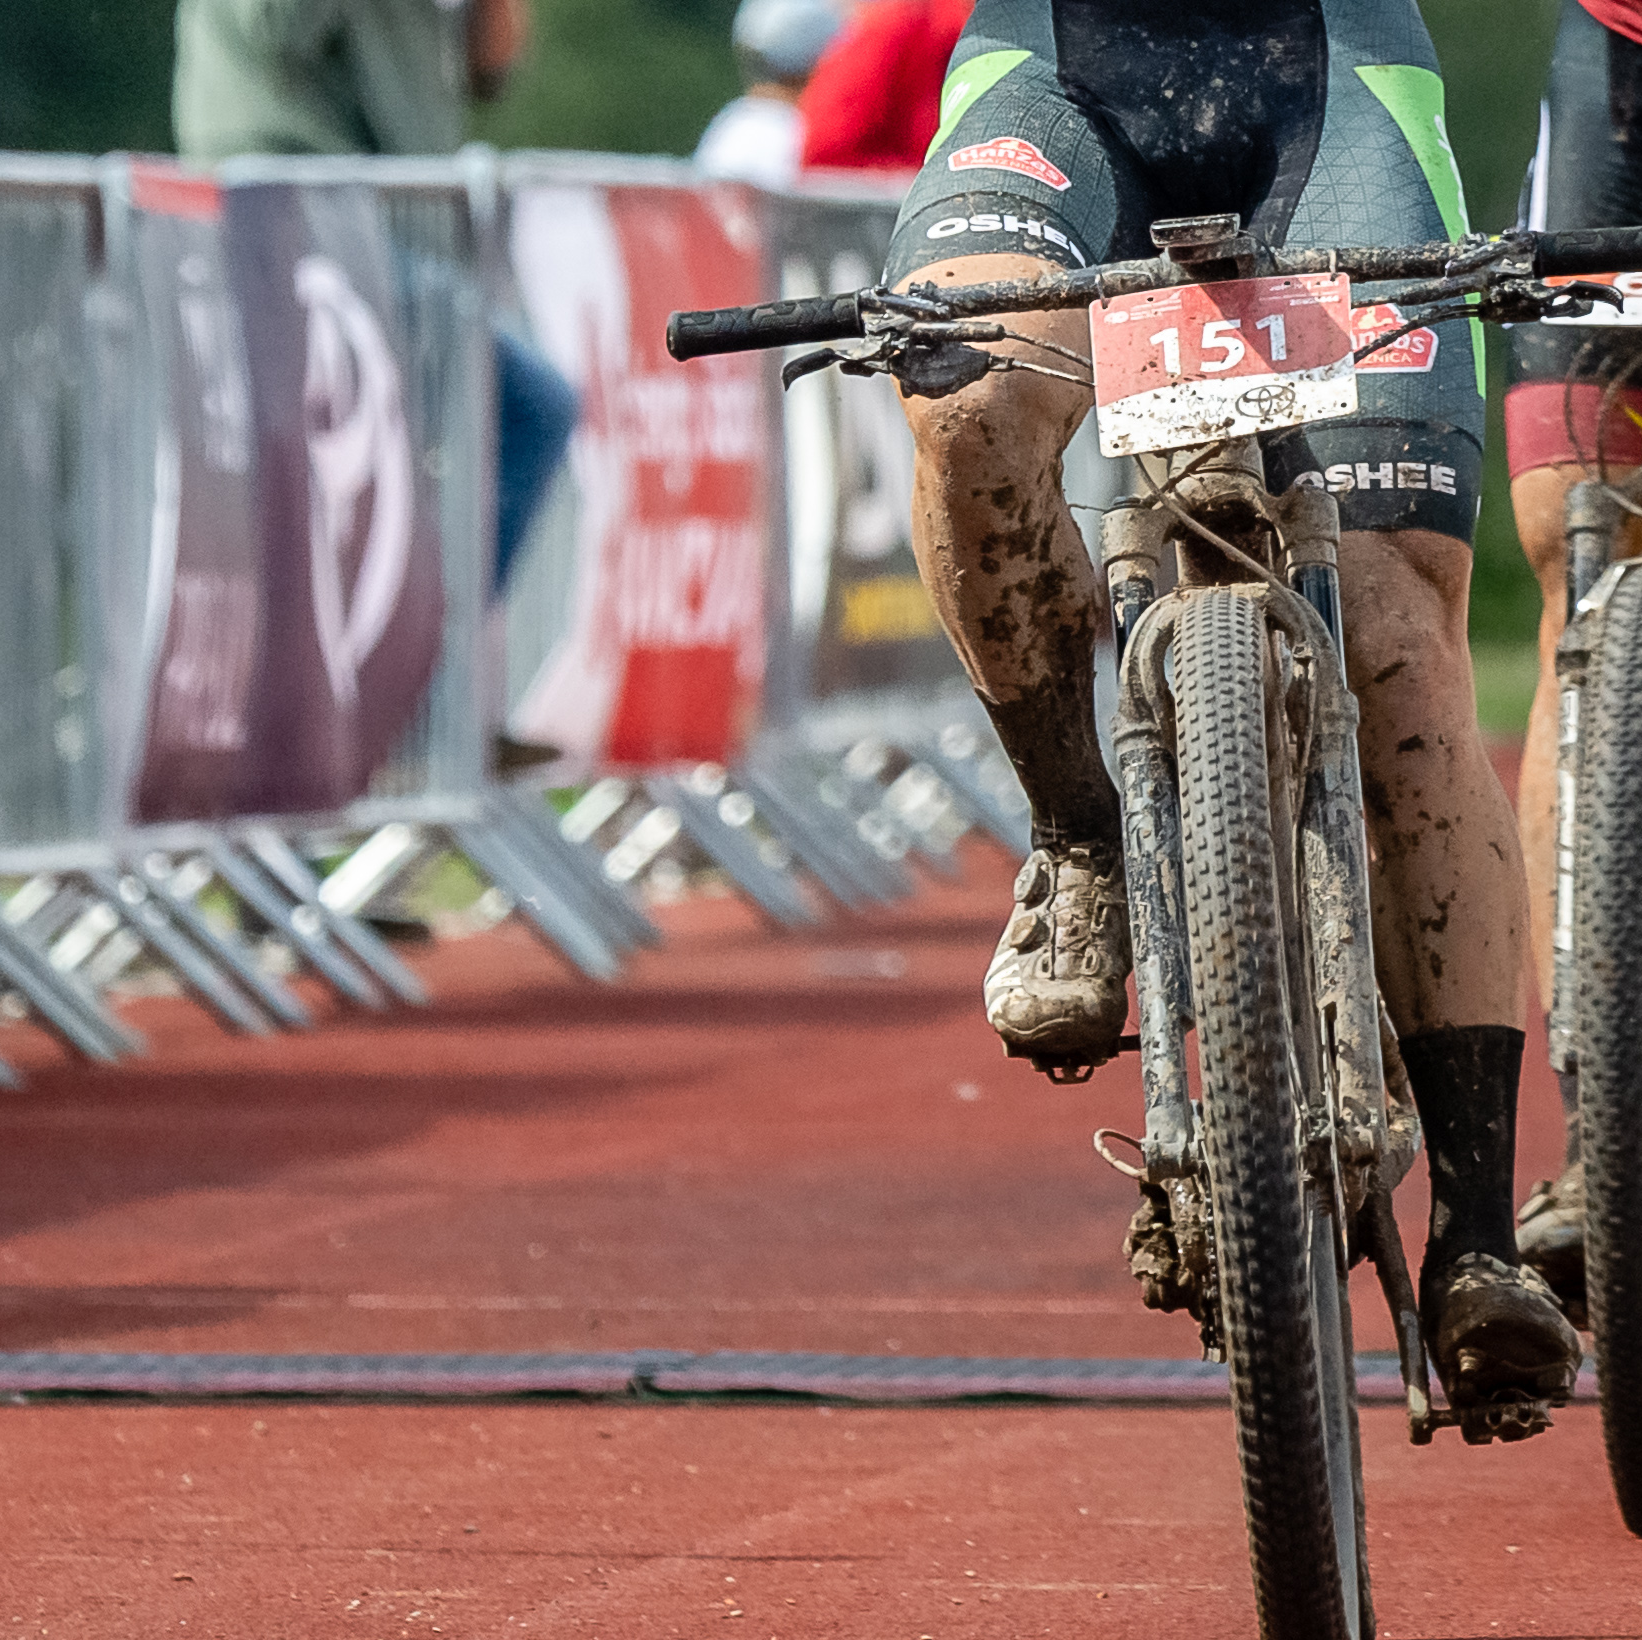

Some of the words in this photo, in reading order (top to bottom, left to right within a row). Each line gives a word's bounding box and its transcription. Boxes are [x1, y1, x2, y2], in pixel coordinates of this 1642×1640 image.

[960, 147, 1061, 183] Hanzas
[1149, 312, 1289, 378] 151
[1292, 461, 1457, 496] OSHEE
